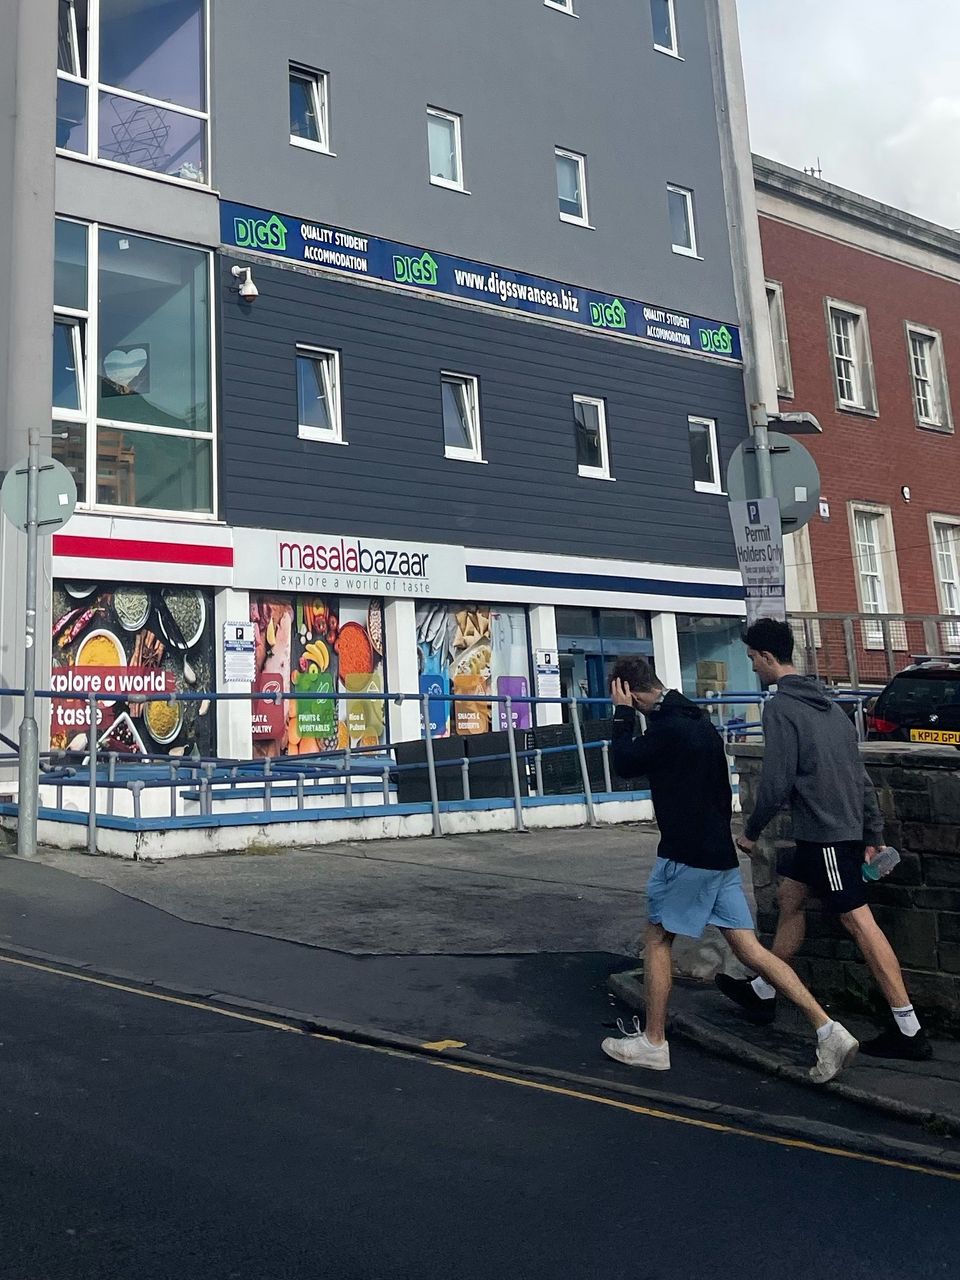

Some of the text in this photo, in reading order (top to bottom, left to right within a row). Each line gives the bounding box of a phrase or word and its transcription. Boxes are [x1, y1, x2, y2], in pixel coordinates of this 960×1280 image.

[234, 218, 283, 248] DIGS
[300, 223, 368, 252] QUALITY STUDENT
[304, 245, 368, 271] ACCOMMODATION
[393, 255, 435, 283] DIGS
[455, 269, 579, 313] www.digsswansea.biz
[590, 302, 623, 327] DIGS
[643, 307, 690, 329] QUALITY STUDENT
[647, 325, 690, 345] ACCOMMODATION
[699, 329, 730, 352] DIGS
[745, 525, 771, 542] Permit
[737, 544, 783, 564] Holders Only
[281, 574, 430, 593] explore a world of taste
[50, 671, 166, 692] xplore a world
[56, 705, 102, 725] taste
[298, 714, 316, 722] FRUITS
[298, 724, 330, 732] VEGETABLES
[918, 731, 939, 741] KP12
